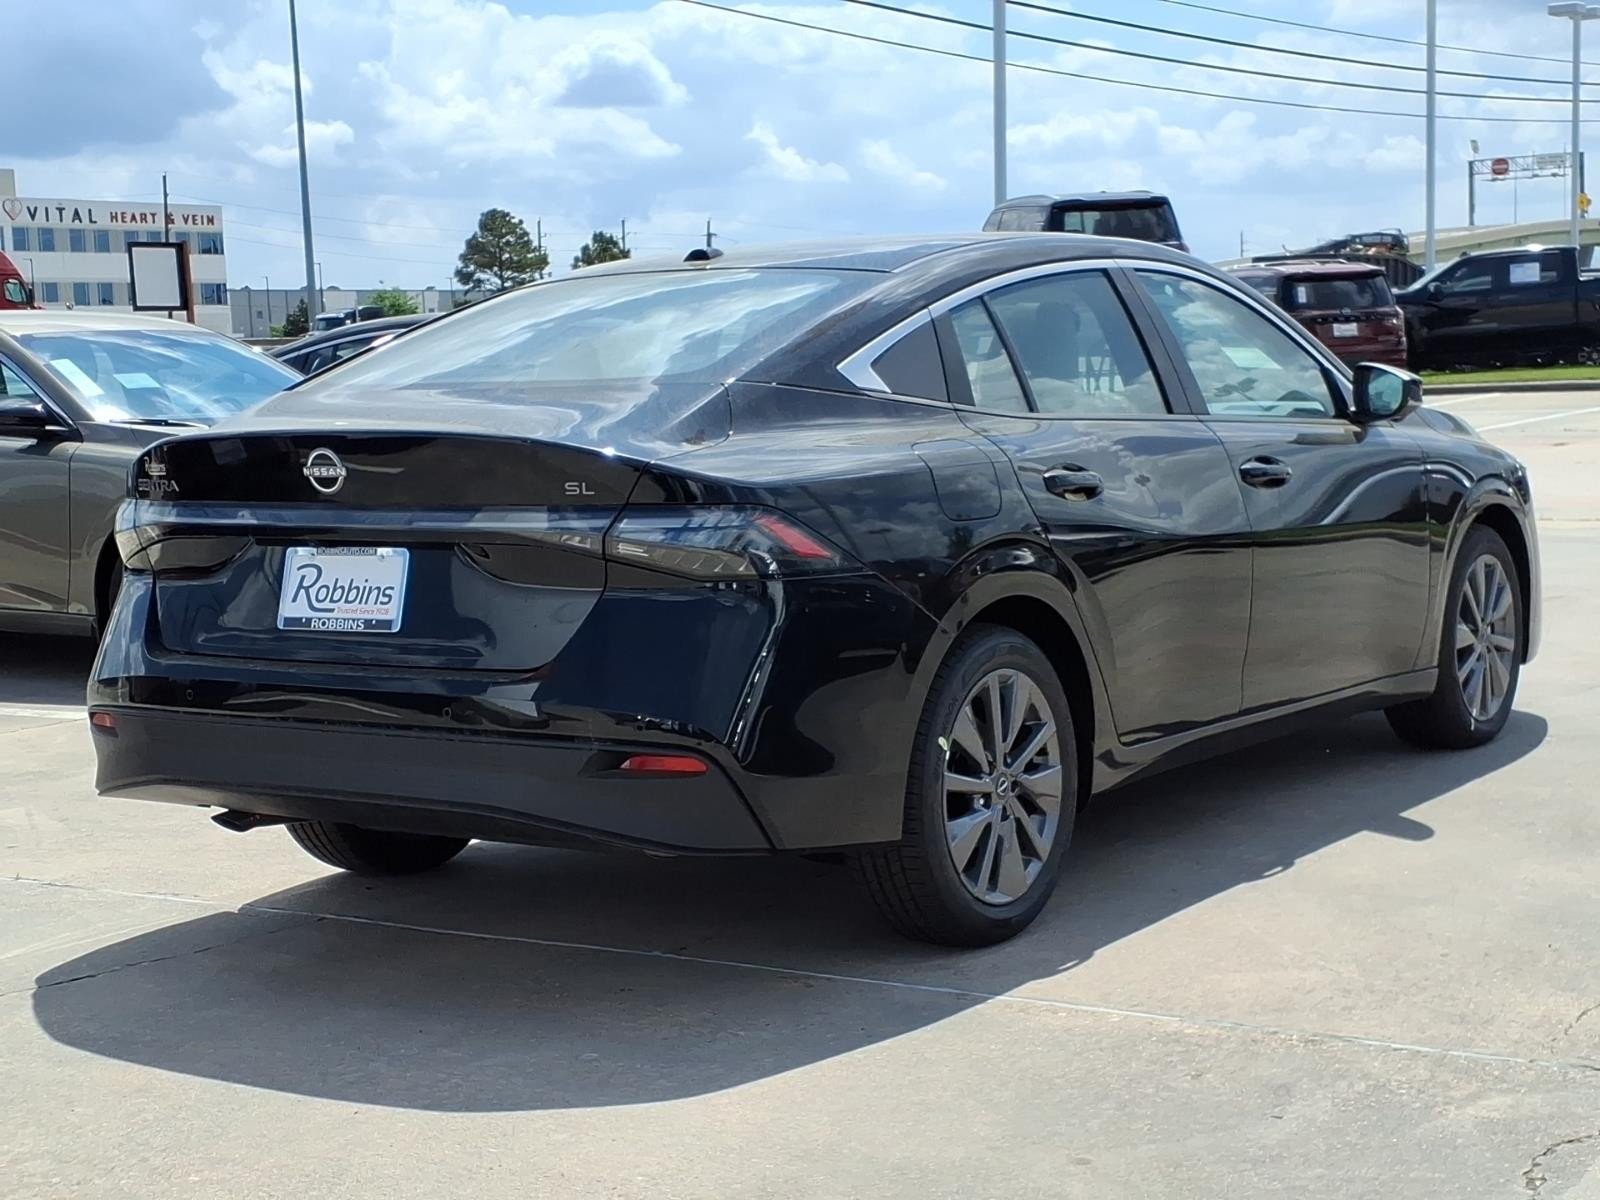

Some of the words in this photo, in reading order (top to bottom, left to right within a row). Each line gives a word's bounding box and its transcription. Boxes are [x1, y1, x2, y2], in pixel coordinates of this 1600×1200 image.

[26, 205, 98, 224] VITAL
[110, 211, 157, 225] HEART
[182, 214, 215, 226] VEIN
[303, 467, 347, 476] NISSAN
[565, 482, 595, 495] SL
[291, 563, 395, 613] Robbins
[311, 618, 365, 630] ROBBINS
